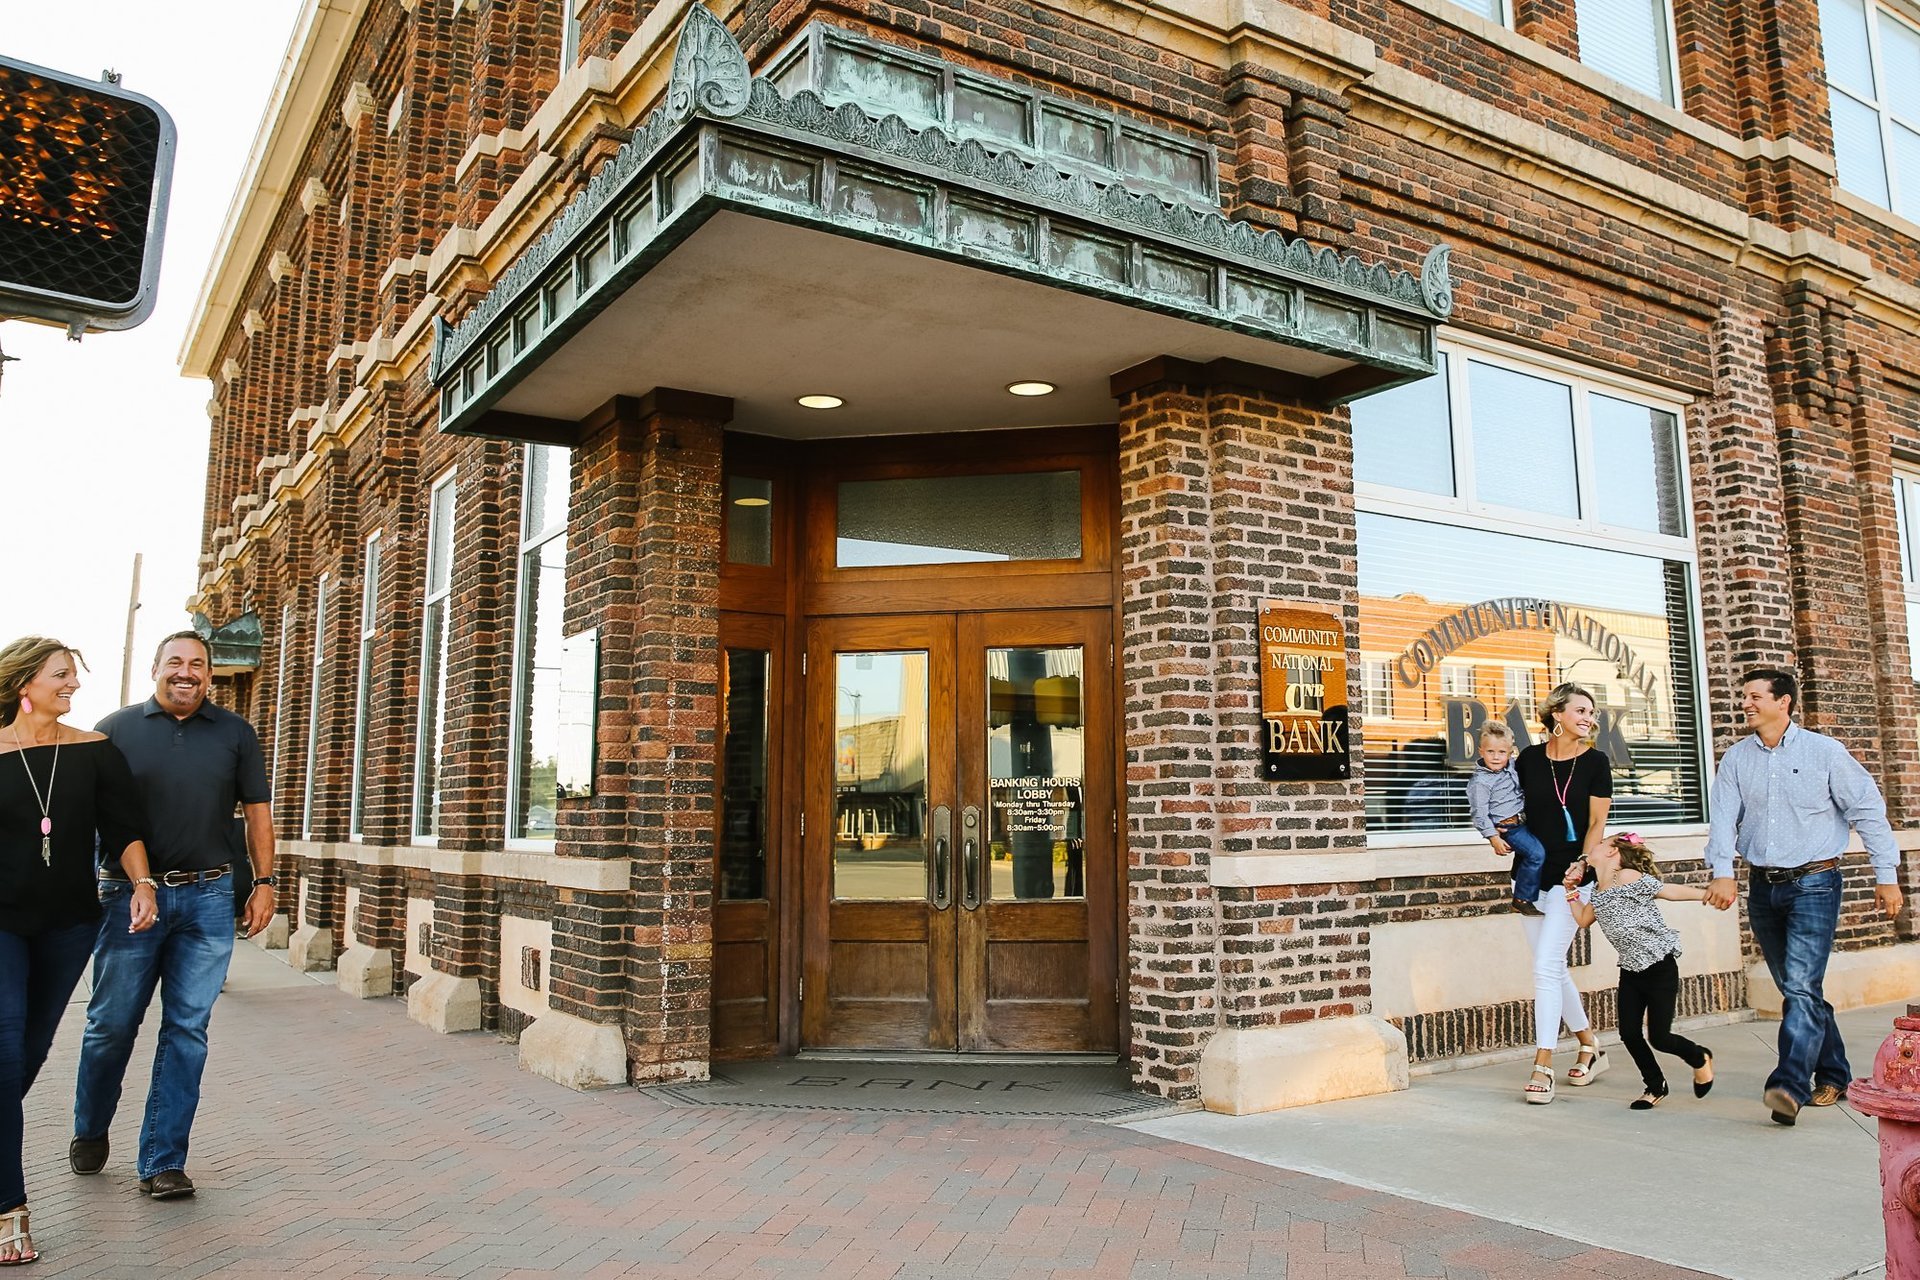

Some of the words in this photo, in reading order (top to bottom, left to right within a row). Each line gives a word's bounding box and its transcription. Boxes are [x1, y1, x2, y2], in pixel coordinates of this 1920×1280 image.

[1263, 626, 1339, 647] COMMUNITY
[1398, 597, 1553, 688] COMMUNITY
[1552, 601, 1658, 702] NATIONAL
[1271, 653, 1335, 672] NATIONAL
[1267, 718, 1345, 754] BANK
[1440, 696, 1635, 769] BAK
[990, 778, 1038, 788] BANKING
[1042, 777, 1081, 787] HOURS
[1017, 790, 1053, 799] LOBBY
[995, 801, 1024, 809] Monday
[1042, 801, 1075, 809] Thursday
[1006, 808, 1065, 817] 8:30am-3:30pm
[1024, 816, 1047, 825] Friday
[1006, 824, 1065, 832] 8:30am-5:00pm
[786, 1075, 1063, 1092] BANK
